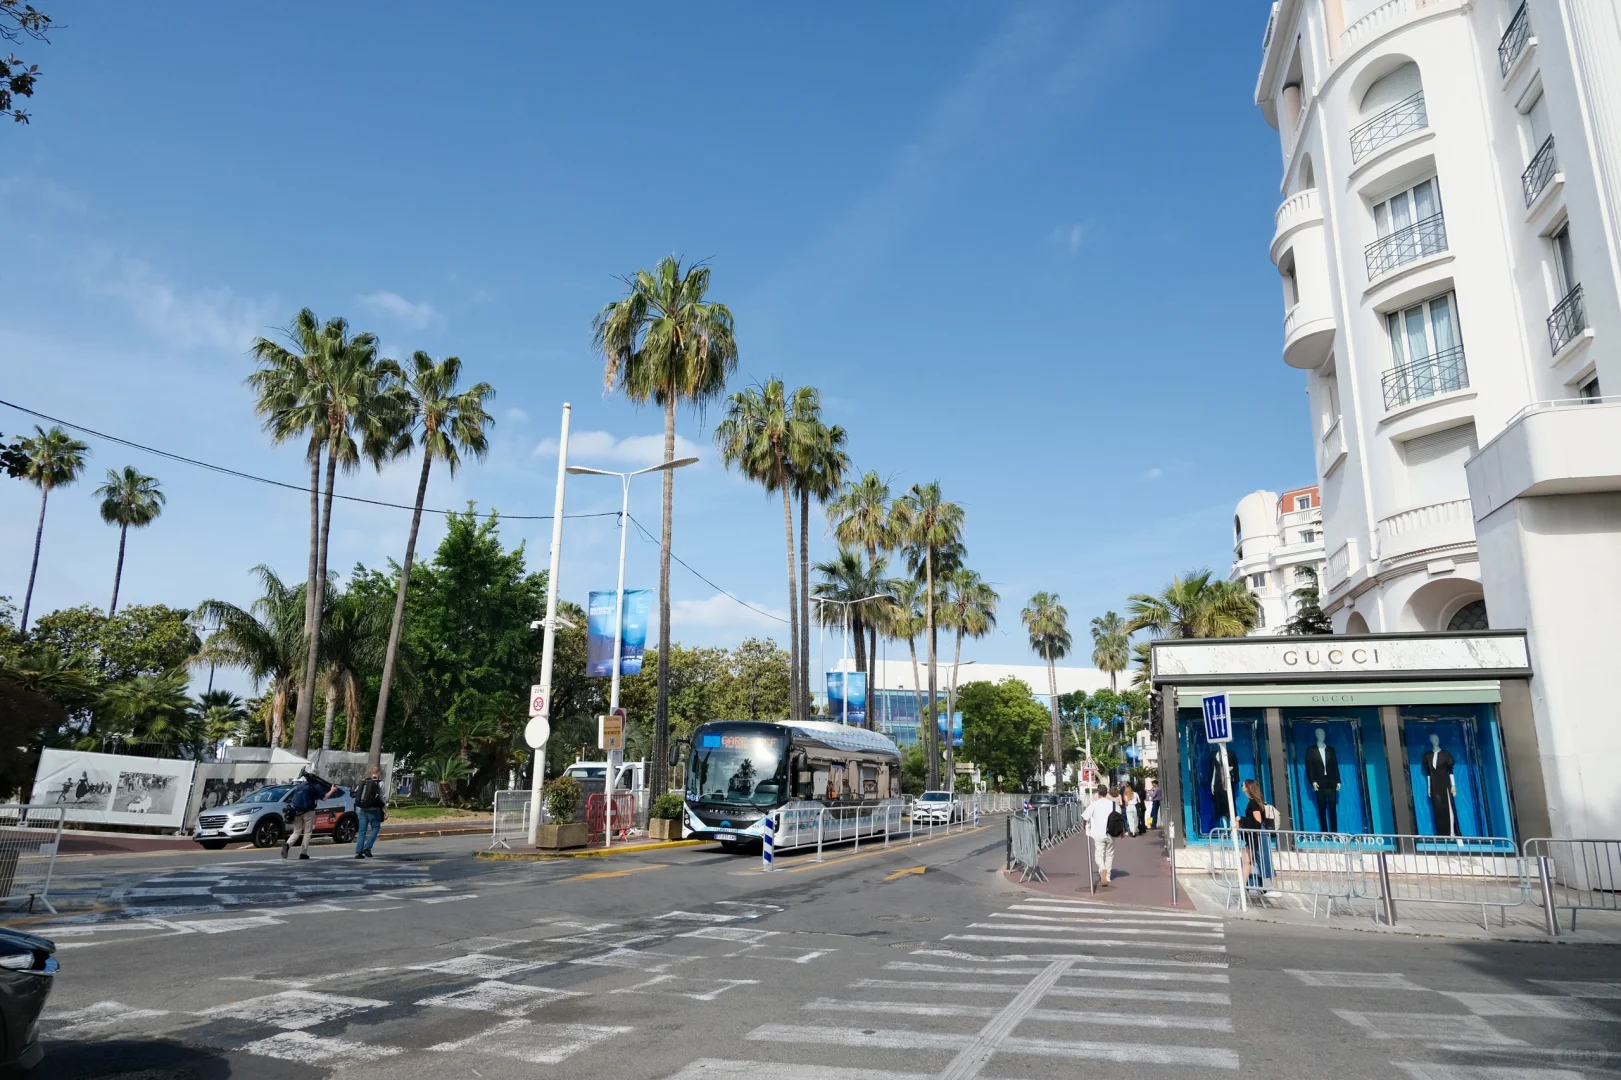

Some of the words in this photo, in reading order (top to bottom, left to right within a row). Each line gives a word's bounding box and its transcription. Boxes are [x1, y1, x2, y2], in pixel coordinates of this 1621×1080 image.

[1283, 648, 1379, 666] GUCCI
[1312, 695, 1354, 703] GUCCI
[721, 735, 747, 745] GARE
